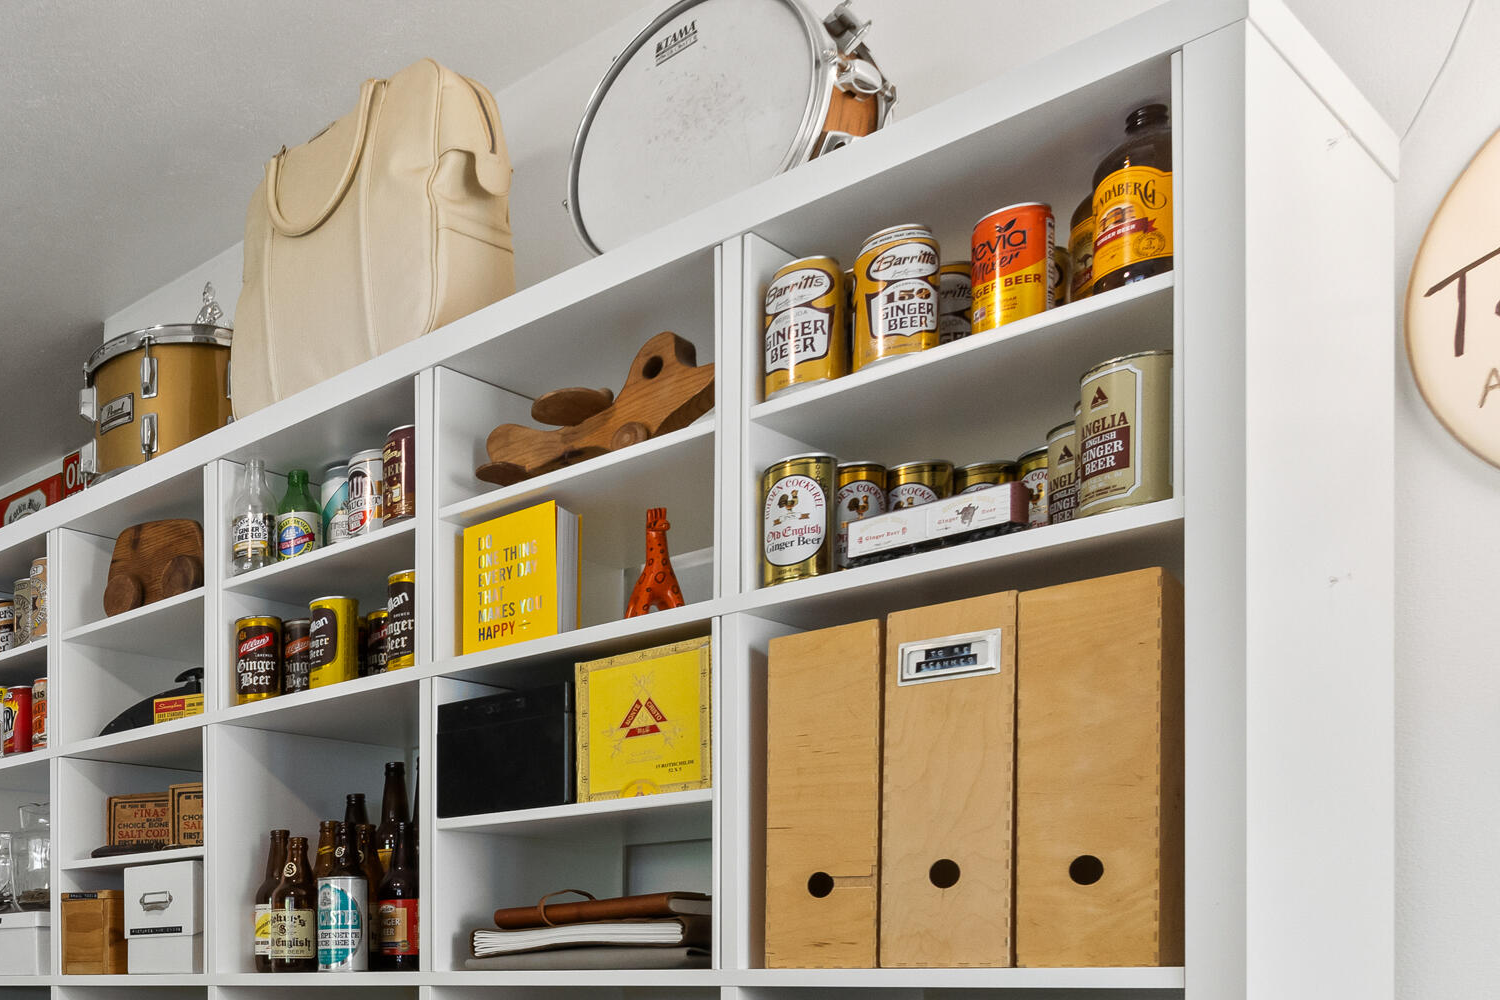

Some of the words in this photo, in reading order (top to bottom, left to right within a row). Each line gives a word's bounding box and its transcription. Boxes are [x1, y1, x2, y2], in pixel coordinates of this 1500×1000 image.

[662, 19, 698, 48] TAMA
[1116, 223, 1136, 235] BEER
[873, 250, 936, 273] Barritts
[766, 274, 824, 306] Barritts
[1004, 274, 1041, 287] BEER
[882, 302, 934, 320] GINGER
[888, 316, 928, 331] BEER
[766, 320, 826, 351] GINGER
[770, 337, 816, 364] BEER
[1082, 411, 1129, 437] ANGLIA
[1086, 431, 1116, 449] ENGLISH
[1082, 440, 1124, 464] GINGER
[1085, 455, 1116, 476] BEER
[478, 534, 492, 551] DO
[767, 530, 781, 543] Old
[782, 524, 821, 538] English
[478, 550, 500, 569] ONE
[503, 538, 538, 562] THING
[767, 539, 797, 554] Ginger
[798, 535, 821, 546] Beer
[478, 565, 512, 587] EVERY
[517, 560, 538, 577] DAY
[478, 586, 504, 605] THAT
[478, 602, 516, 623] MAKES
[519, 595, 543, 614] YOU
[478, 621, 516, 642] HAPPY
[236, 659, 275, 672] Ginger
[920, 657, 973, 671] SCANNED
[241, 672, 270, 689] Beer
[625, 704, 640, 726] MONTE
[647, 701, 662, 721] CRISTO
[118, 830, 142, 839] SALT
[275, 937, 310, 951] English
